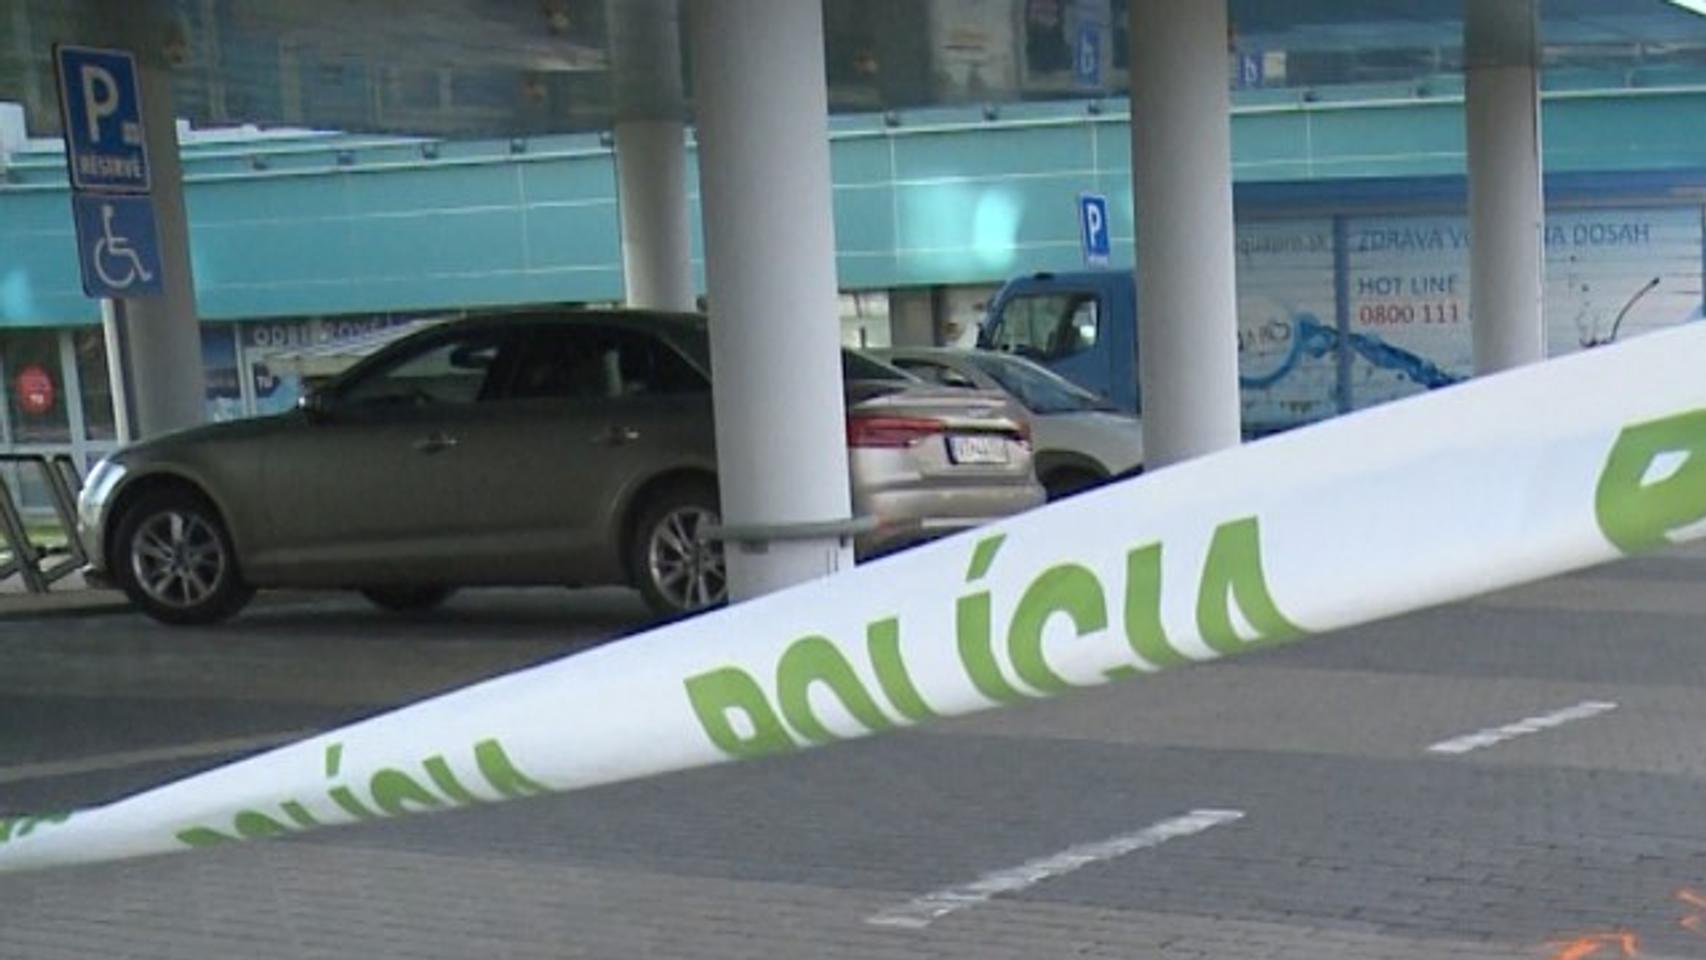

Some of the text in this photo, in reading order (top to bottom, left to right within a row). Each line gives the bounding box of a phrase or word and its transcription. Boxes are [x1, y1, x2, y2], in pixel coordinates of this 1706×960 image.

[82, 65, 119, 143] P
[1086, 203, 1102, 247] P
[1361, 228, 1443, 251] ZDRAVA
[1573, 222, 1649, 246] DOSAH
[1359, 277, 1402, 296] HOT
[1359, 305, 1414, 326] 0800
[1423, 303, 1459, 324] 111
